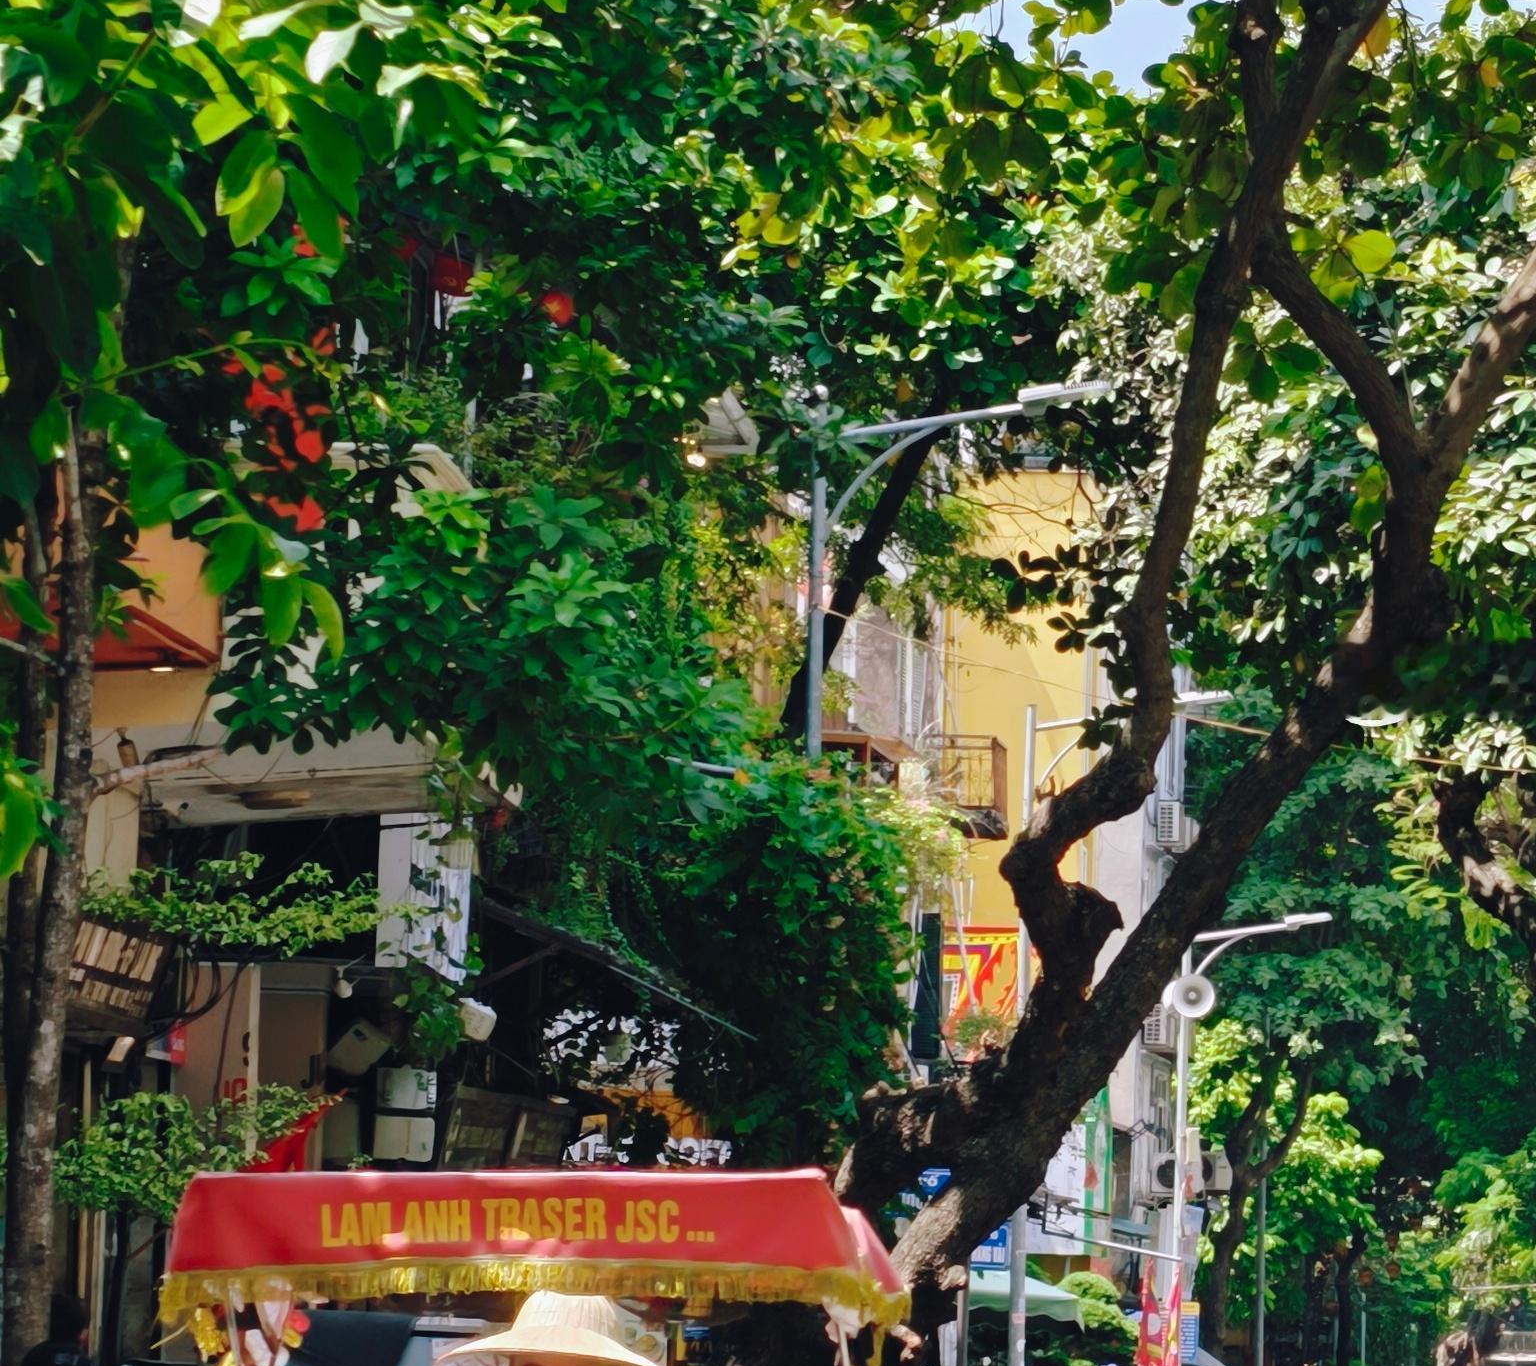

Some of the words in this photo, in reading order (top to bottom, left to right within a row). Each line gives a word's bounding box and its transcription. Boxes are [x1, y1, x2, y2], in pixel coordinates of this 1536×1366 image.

[321, 1200, 391, 1248] LAM
[403, 1199, 471, 1244] ANH
[481, 1197, 607, 1241] TRASER
